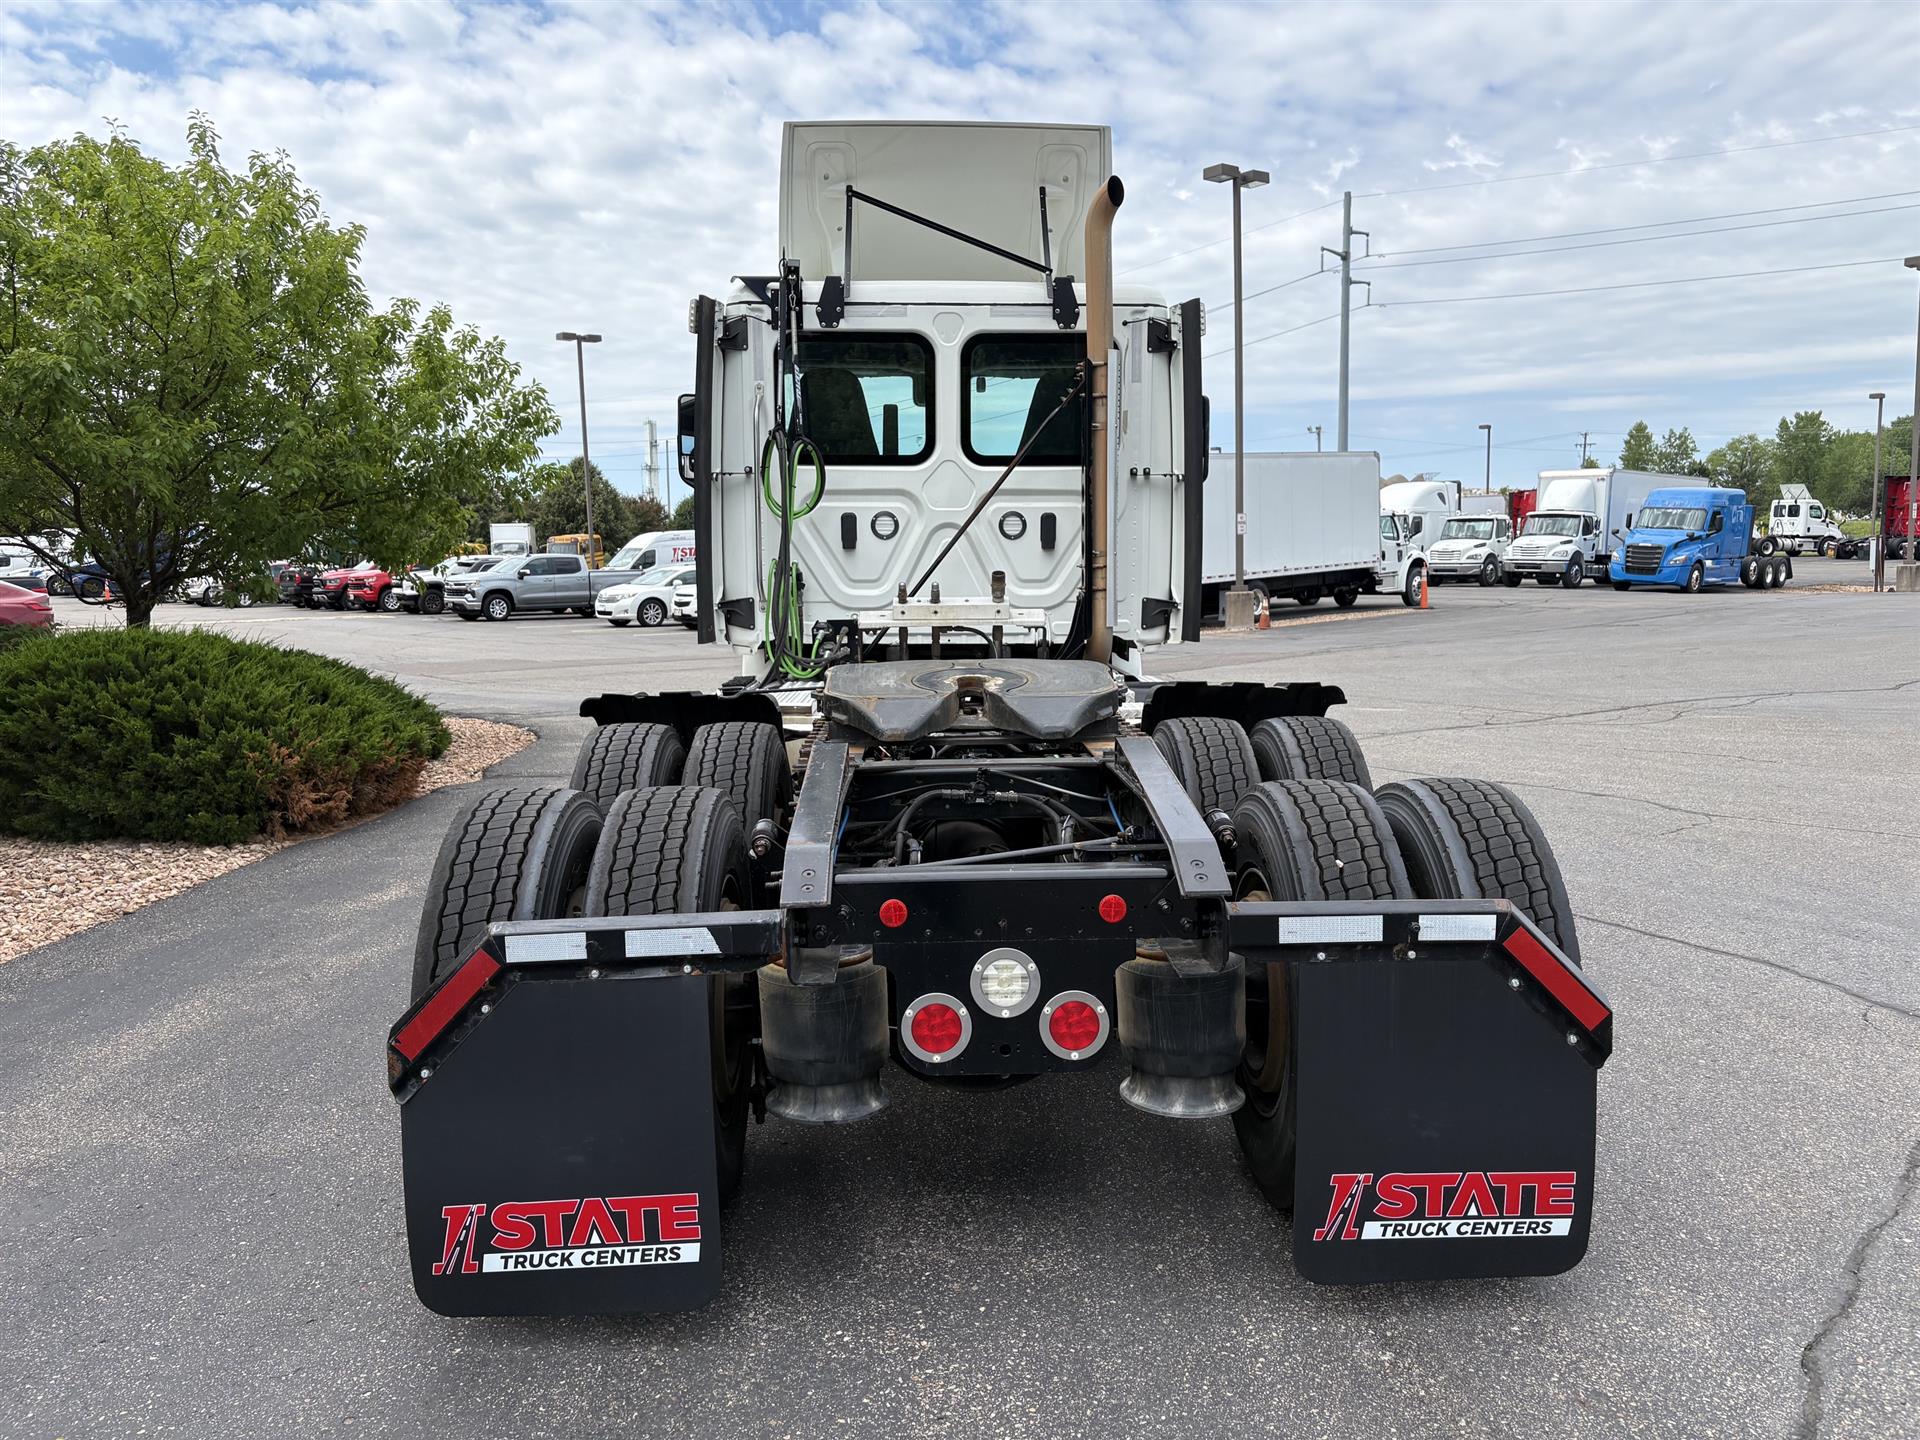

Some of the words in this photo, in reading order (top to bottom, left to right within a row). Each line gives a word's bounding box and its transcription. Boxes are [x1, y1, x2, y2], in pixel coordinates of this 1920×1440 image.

[1379, 1222, 1450, 1237] TRUCK
[1456, 1220, 1553, 1236] CENTERS
[500, 1251, 575, 1270] TRUCK
[580, 1246, 681, 1266] CENTERS
